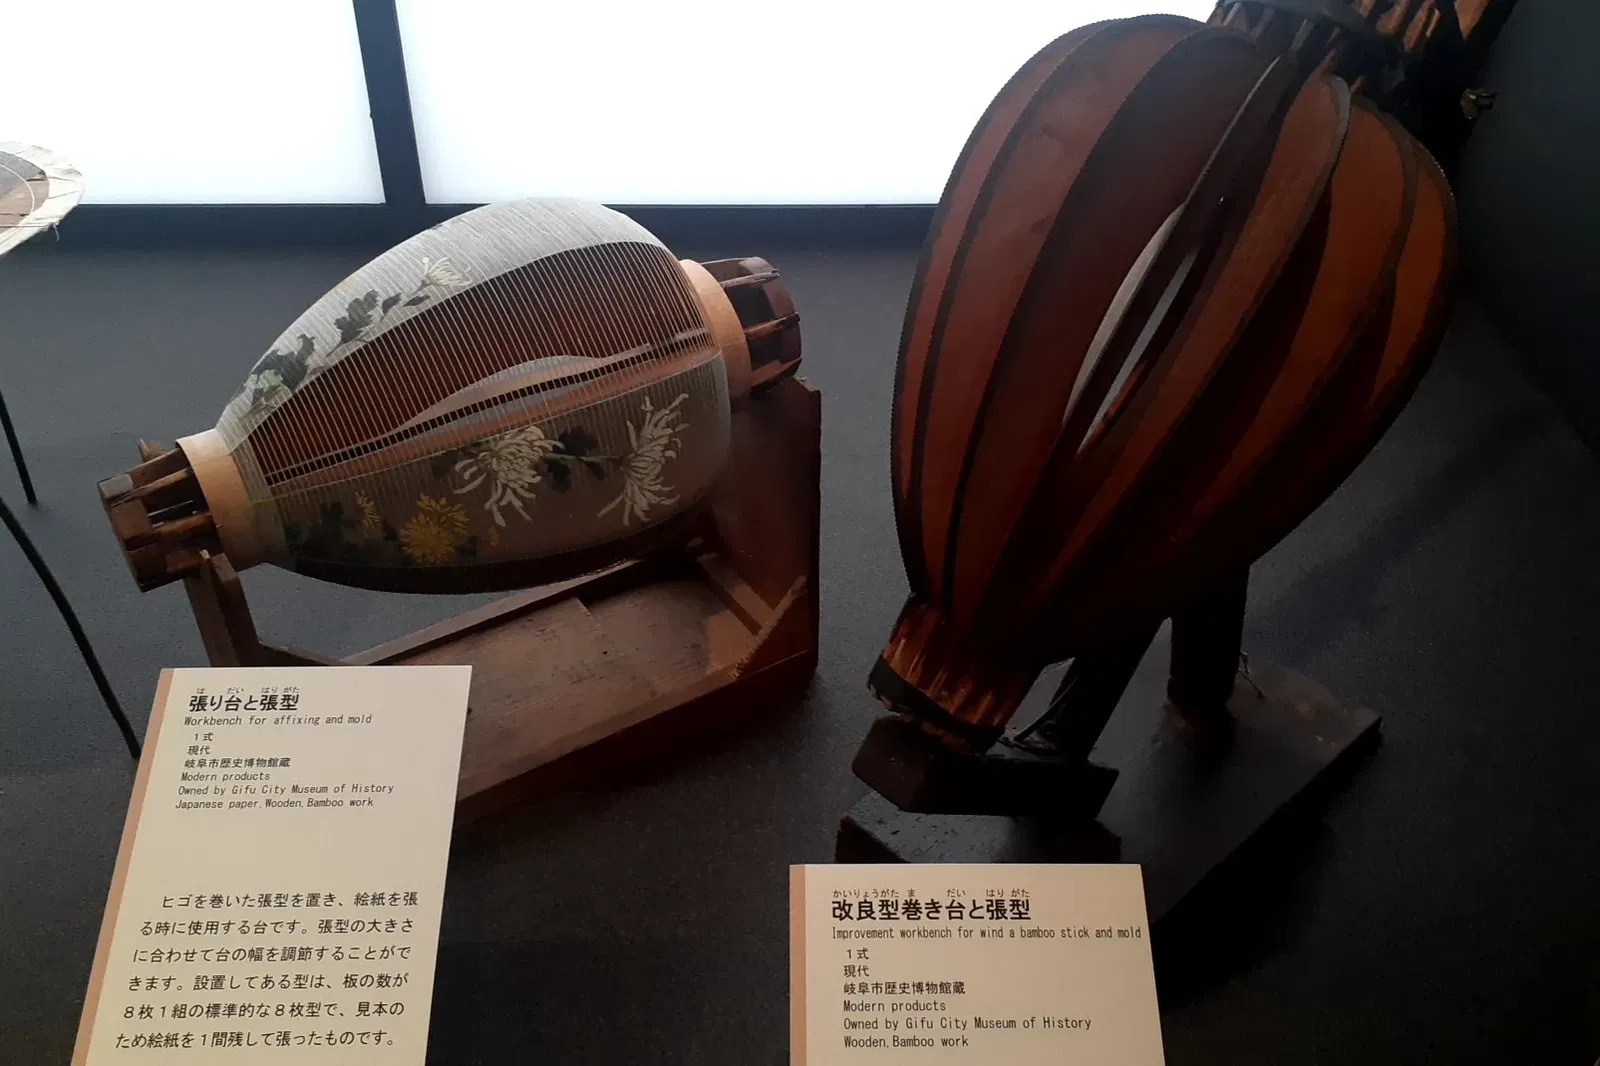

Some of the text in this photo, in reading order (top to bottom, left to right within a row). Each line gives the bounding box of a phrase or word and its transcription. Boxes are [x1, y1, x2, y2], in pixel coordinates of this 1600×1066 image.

[188, 694, 300, 712] 張り台と張型
[184, 713, 372, 727] Workbench for affixing and mold
[187, 745, 211, 756] 現代
[184, 757, 291, 769] 岐阜市歴史博物館蔵
[180, 771, 271, 783] Modern products
[178, 783, 395, 797] Owned by Gifu City Museum of History
[175, 799, 223, 811] Japanese
[349, 797, 374, 807] work
[162, 891, 419, 910] ヒゴを巻いた張型を置き、絵紙を張
[831, 899, 1032, 921] 改良型巻き台と張型
[139, 918, 414, 937] る時に使用する台です。張型の大きさ
[832, 926, 1141, 940] Improvement workbench for wind a bamboo stick and mold
[132, 945, 412, 964] に合わせて台の幅を調節することがで
[843, 964, 870, 978] 現代
[128, 972, 409, 992] きます。設置してある型は、板の数が
[843, 981, 966, 996] 岐阜市歴史博物館蔵
[843, 1000, 946, 1014] Modern products
[843, 1016, 1092, 1032] Owned by Gifu City Museum of History
[941, 1035, 969, 1047] work
